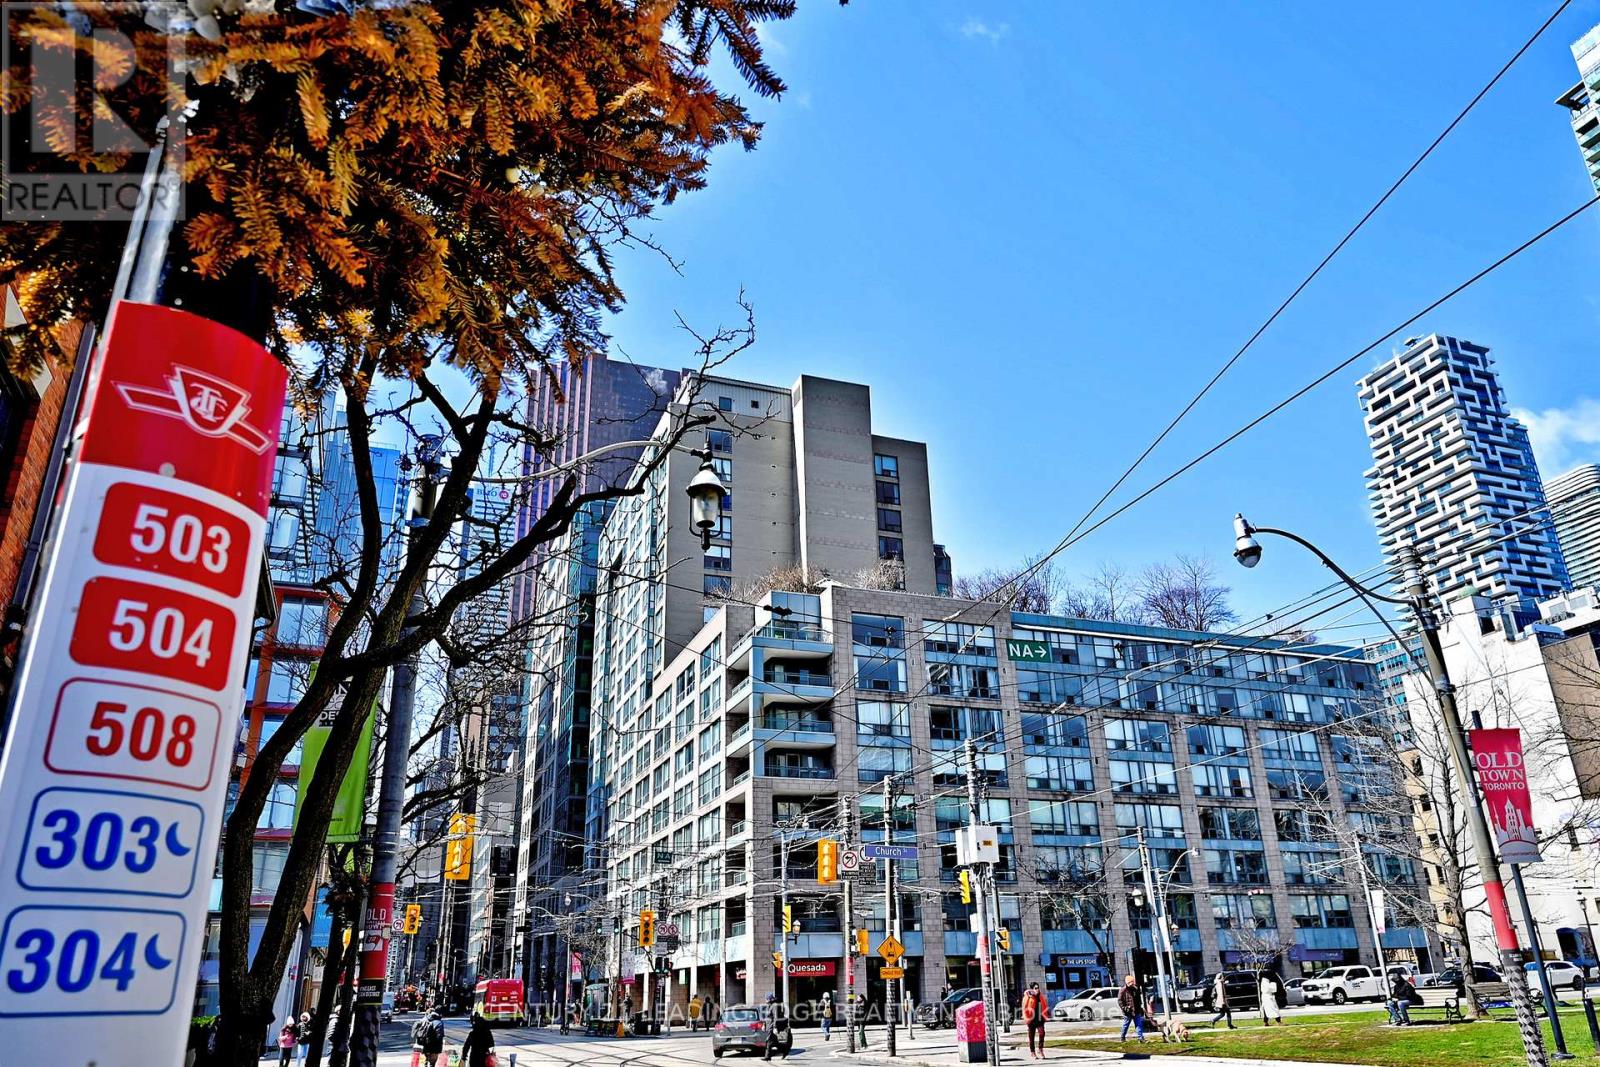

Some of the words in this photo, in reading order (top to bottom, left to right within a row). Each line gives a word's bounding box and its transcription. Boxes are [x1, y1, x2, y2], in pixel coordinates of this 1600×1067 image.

[130, 503, 232, 574] 503
[108, 599, 213, 669] 504
[1008, 643, 1034, 658] NA
[86, 702, 196, 767] 508
[1476, 751, 1522, 769] OLD
[1480, 768, 1524, 782] TOWN
[1484, 782, 1525, 791] TORONTO
[35, 809, 161, 874] 303
[875, 846, 902, 856] Church
[6, 928, 140, 994] 304
[787, 963, 827, 973] Quesada
[1090, 972, 1100, 980] 52
